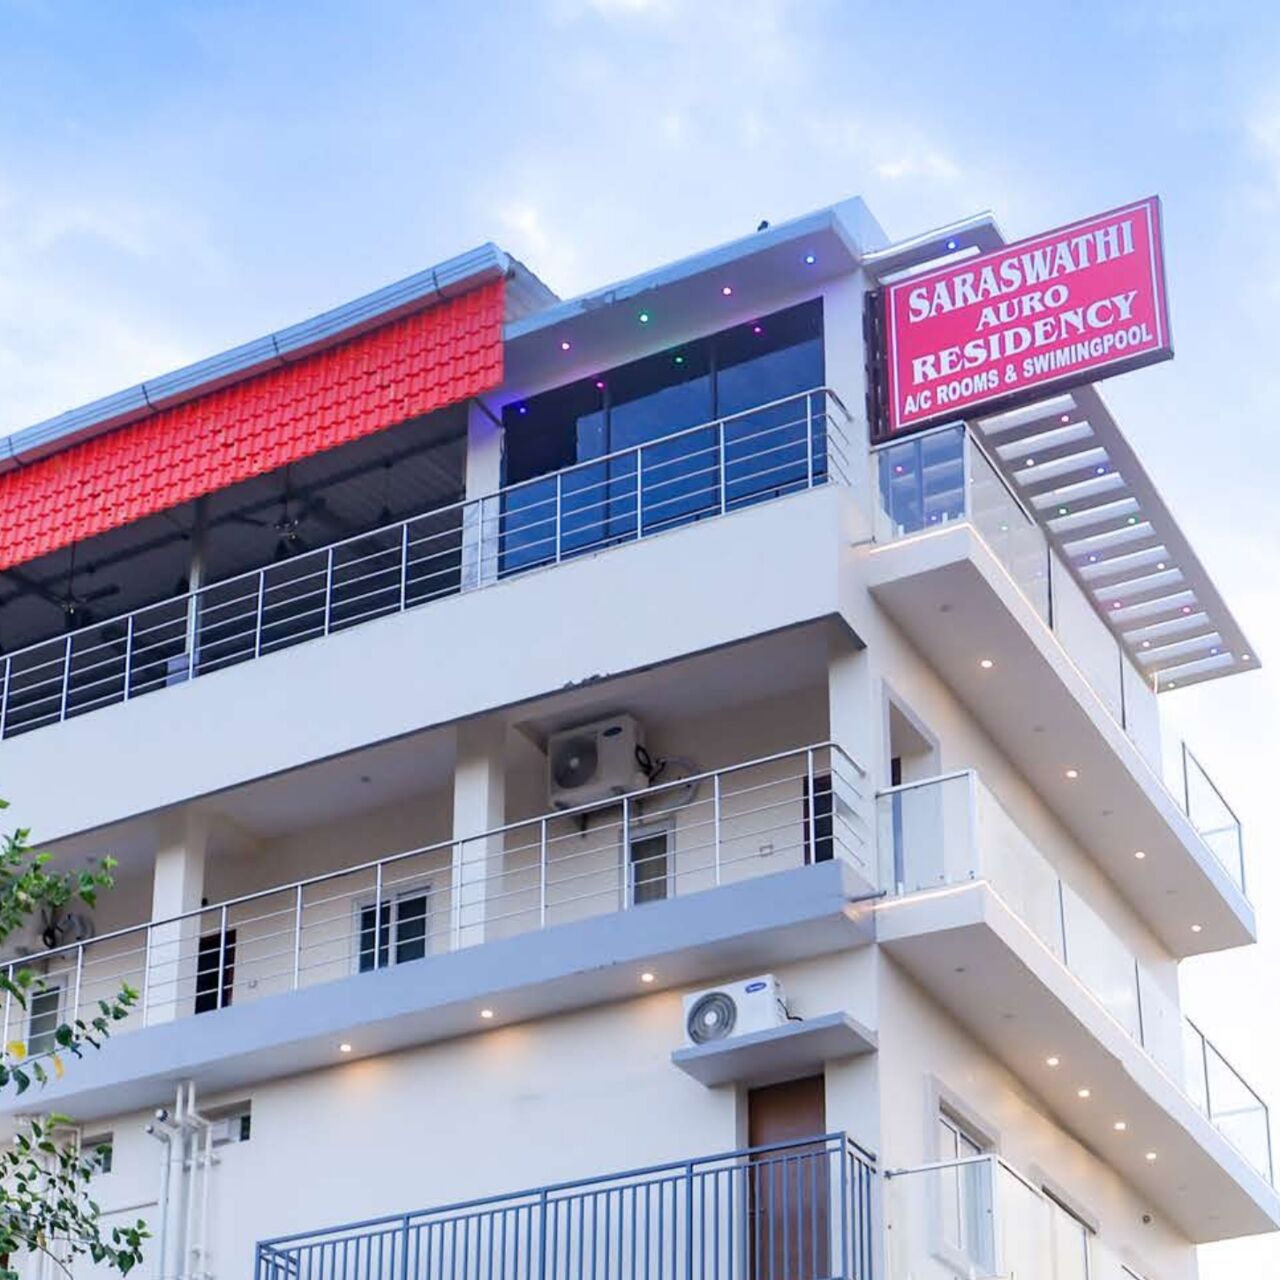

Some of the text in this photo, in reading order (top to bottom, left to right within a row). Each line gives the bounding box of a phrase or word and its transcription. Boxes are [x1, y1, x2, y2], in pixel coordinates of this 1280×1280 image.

[908, 220, 1135, 323] SARASWATHI
[976, 284, 1069, 331] AURO
[904, 323, 1153, 415] A/C ROOMS & SWIMINGPOOL
[912, 290, 1138, 385] RESIDENCY
